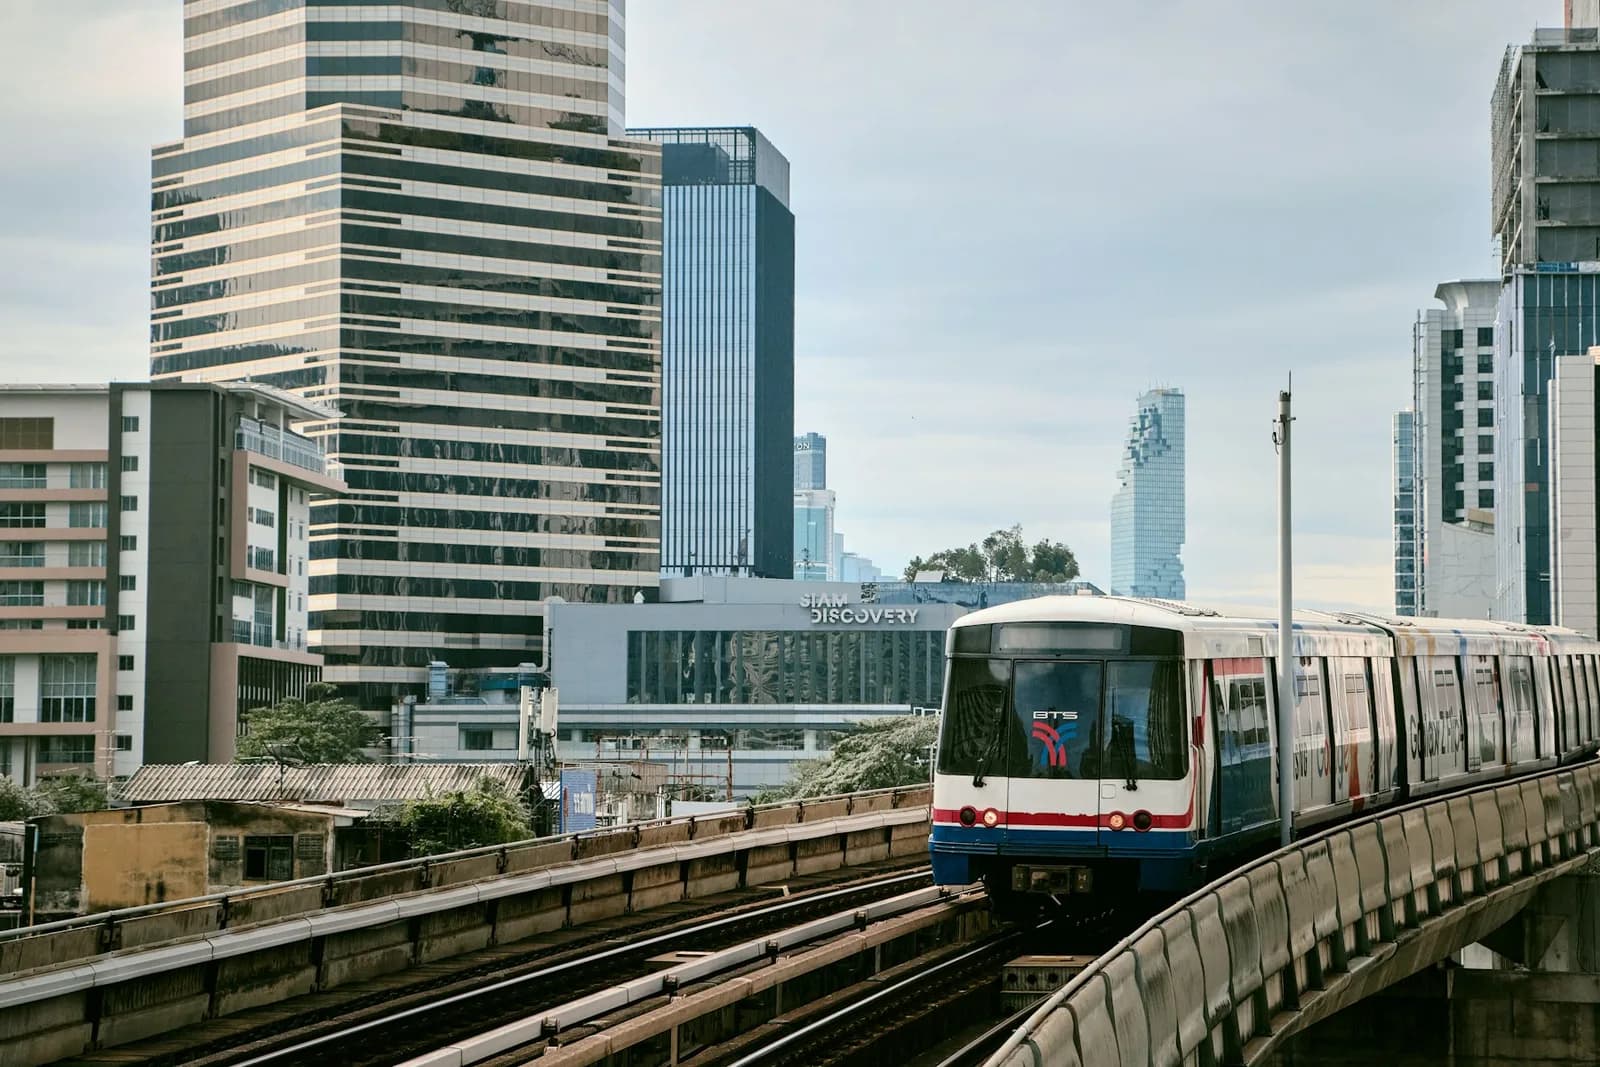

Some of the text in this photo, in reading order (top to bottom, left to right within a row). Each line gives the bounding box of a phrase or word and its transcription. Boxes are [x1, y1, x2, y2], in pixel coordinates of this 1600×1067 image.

[800, 592, 848, 608] SIAM
[811, 608, 919, 624] DISCOVERY
[1033, 711, 1078, 720] BTS
